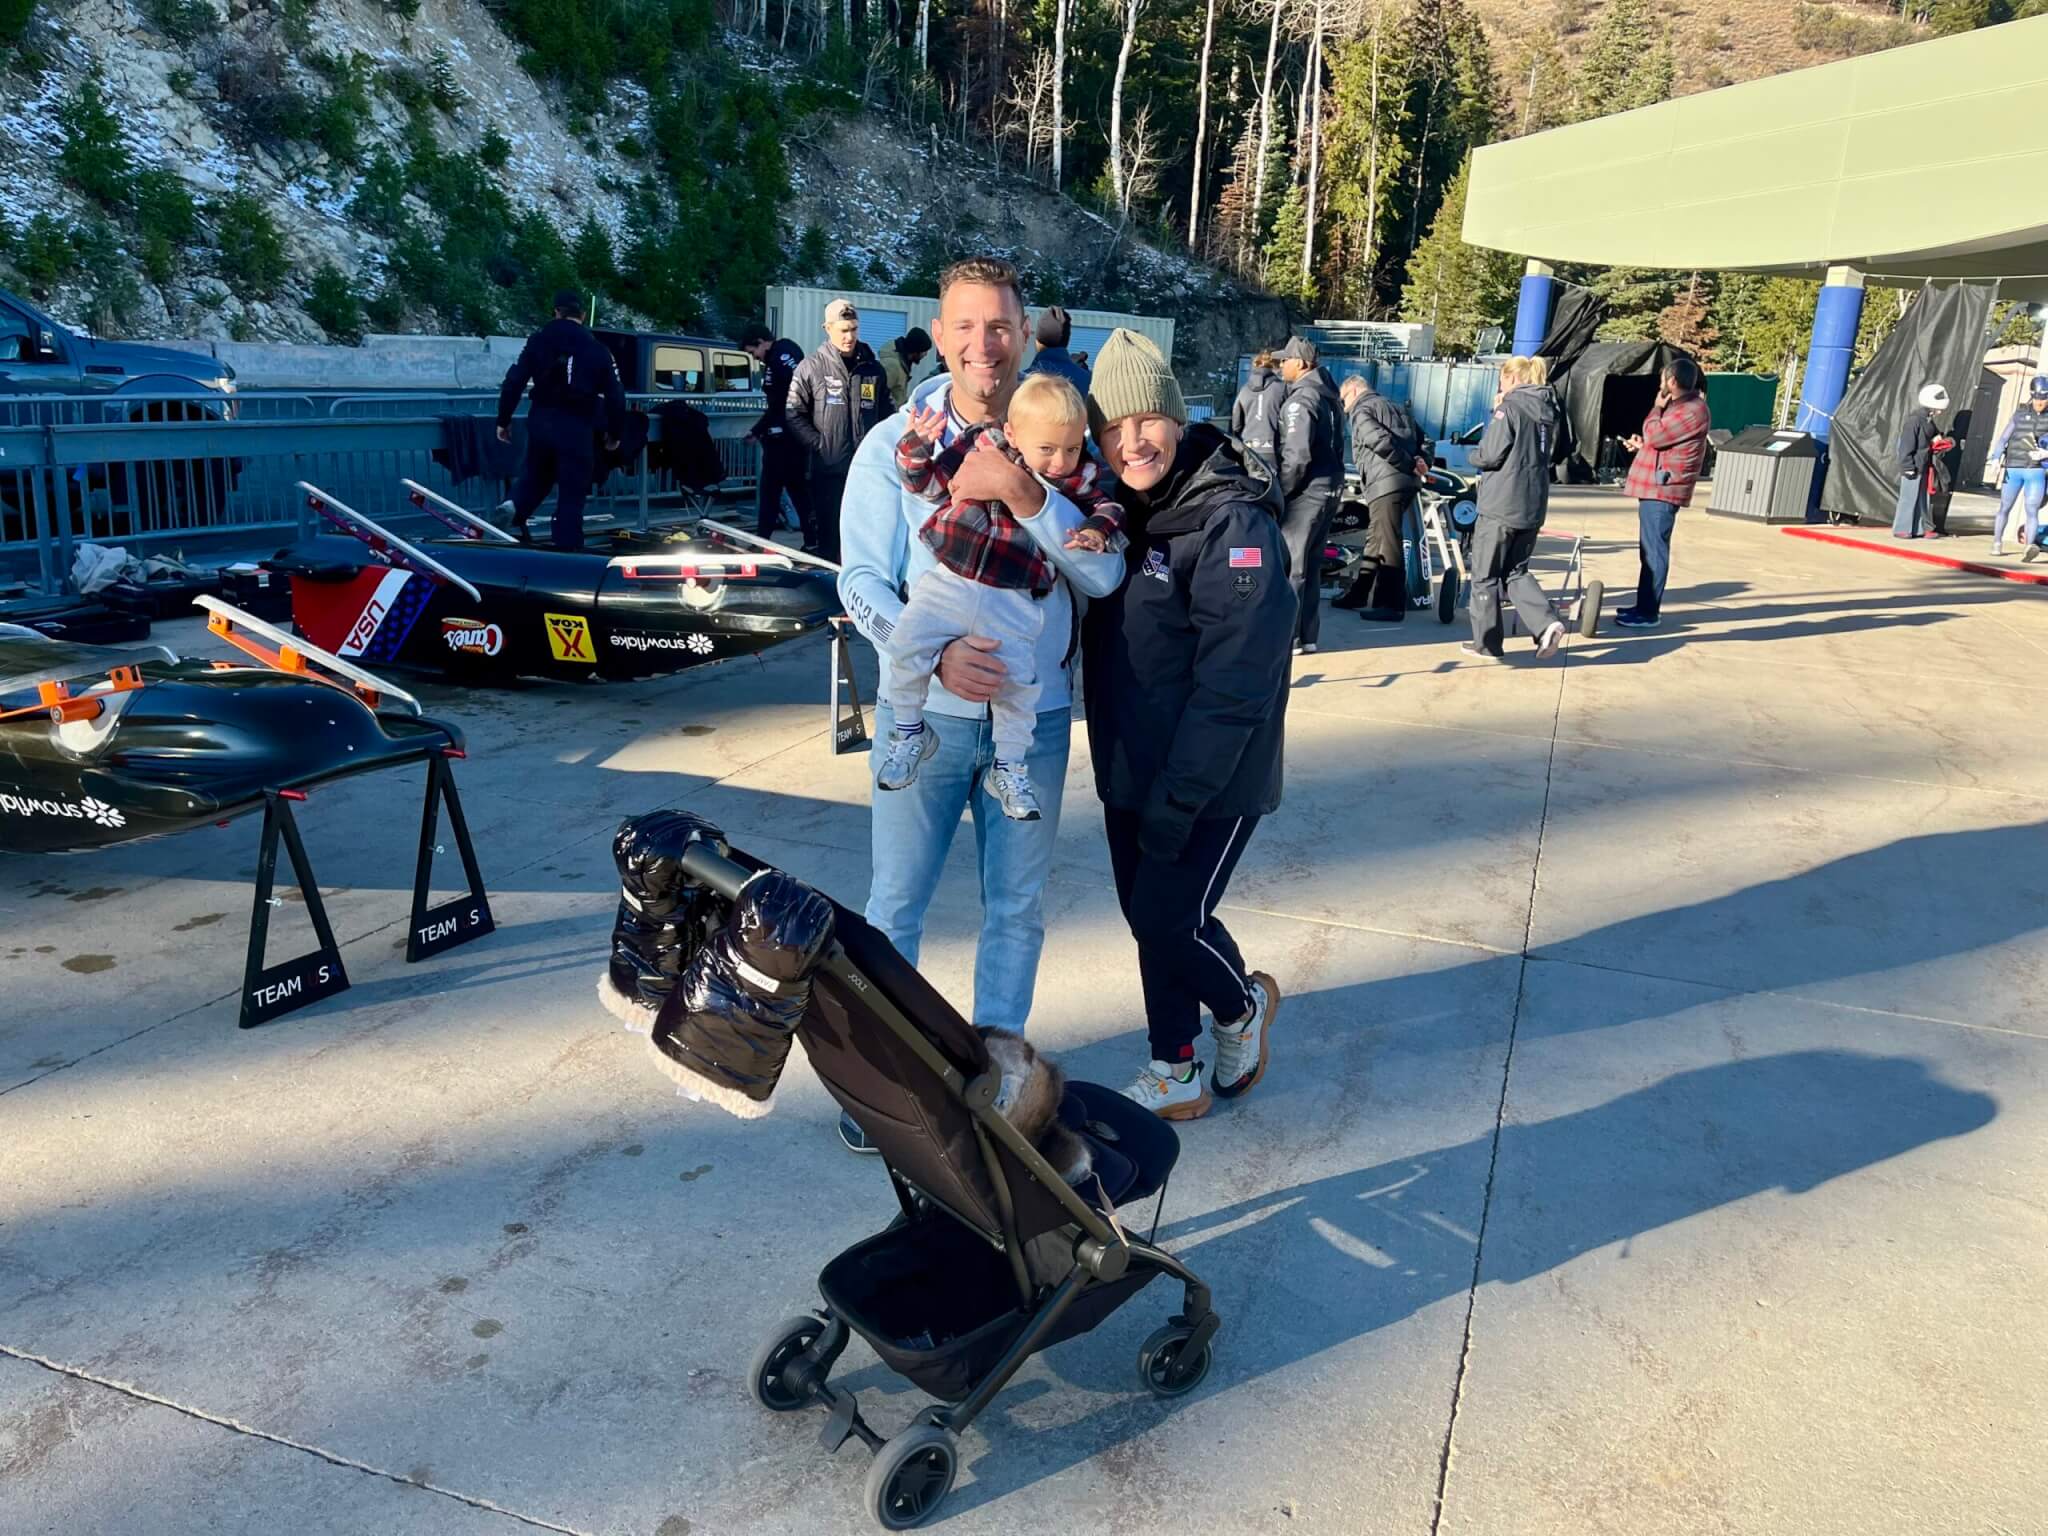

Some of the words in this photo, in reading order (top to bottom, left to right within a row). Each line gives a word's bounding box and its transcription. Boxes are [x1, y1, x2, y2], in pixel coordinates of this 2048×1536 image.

[548, 618, 584, 629] KOA
[846, 586, 873, 631] USA
[347, 599, 385, 651] USA
[443, 624, 503, 656] Cane's
[610, 634, 686, 651] snowflake
[0, 793, 83, 818] snowfla
[418, 917, 457, 945] TEAM
[252, 975, 302, 1008] TEAM
